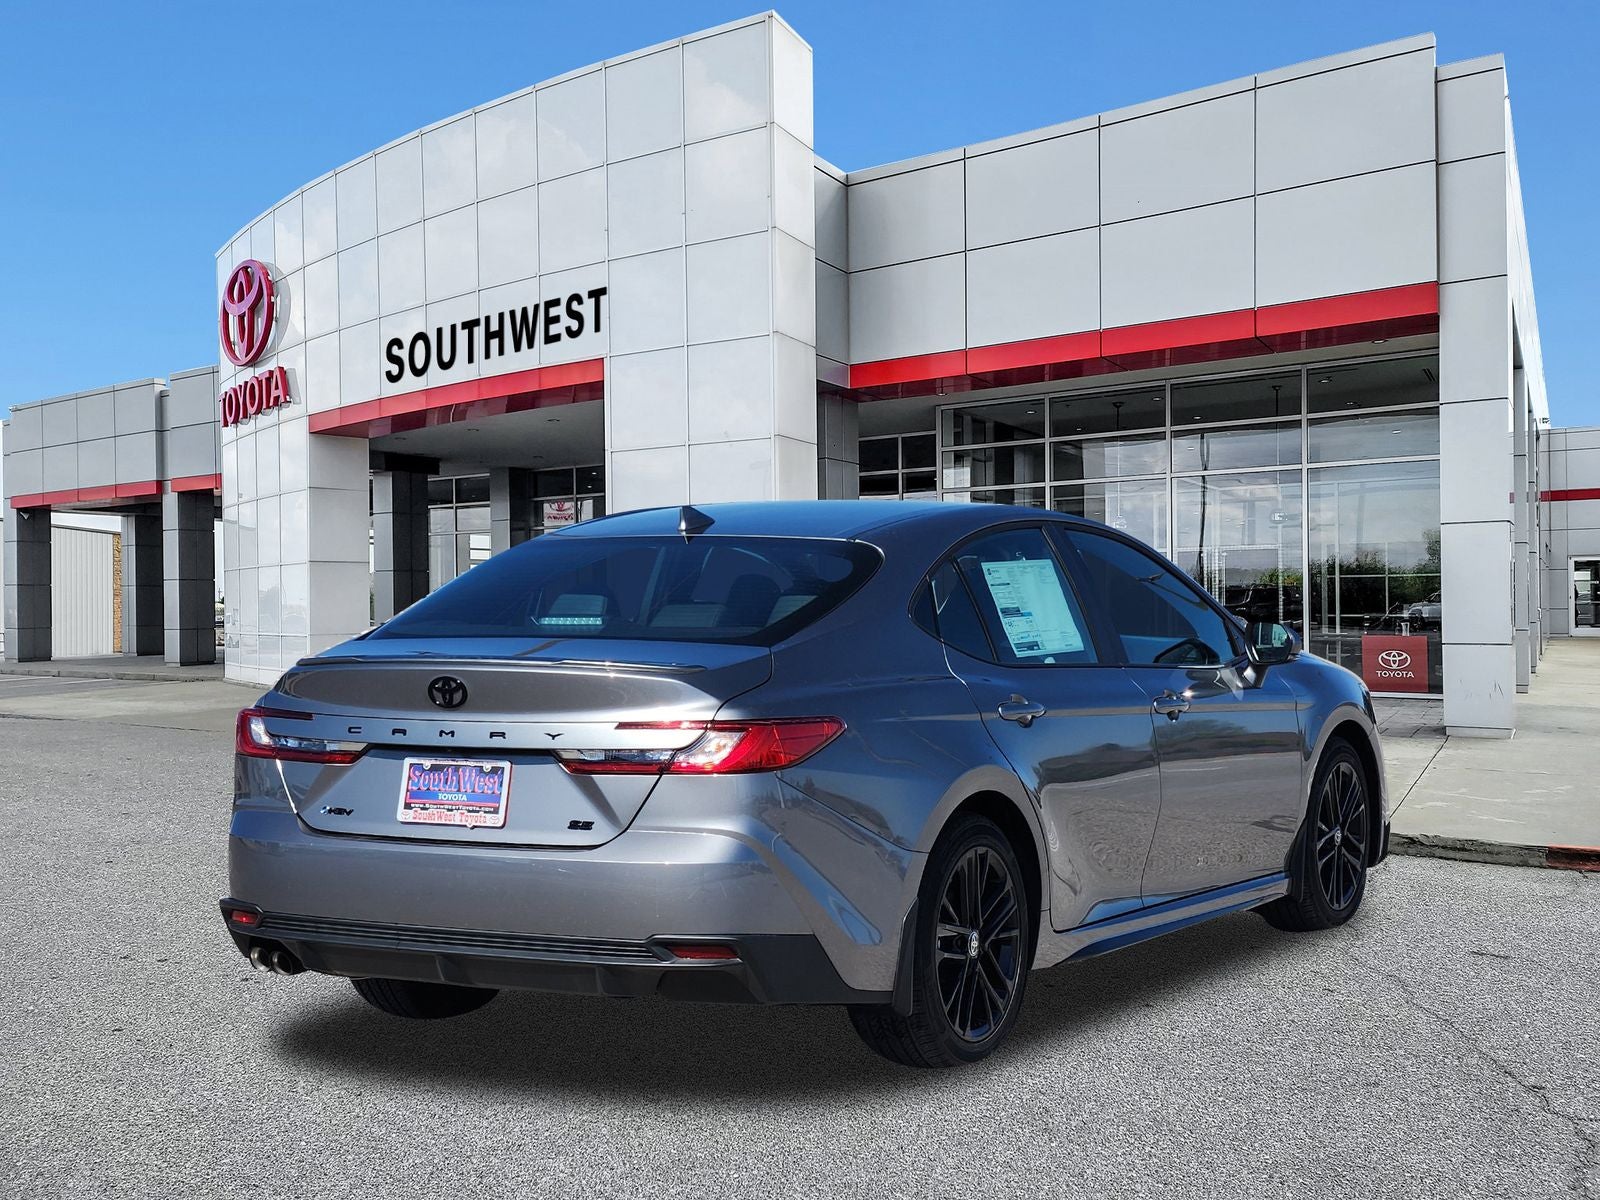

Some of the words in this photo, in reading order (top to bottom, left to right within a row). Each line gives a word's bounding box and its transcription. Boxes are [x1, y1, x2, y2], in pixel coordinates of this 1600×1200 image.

[385, 286, 608, 383] SOUTHWEST
[218, 366, 292, 428] TOYOTA
[1376, 670, 1414, 678] TOYOTA
[347, 726, 564, 741] CAMRY
[438, 793, 468, 801] TOYOTA
[459, 812, 488, 824] Toyota
